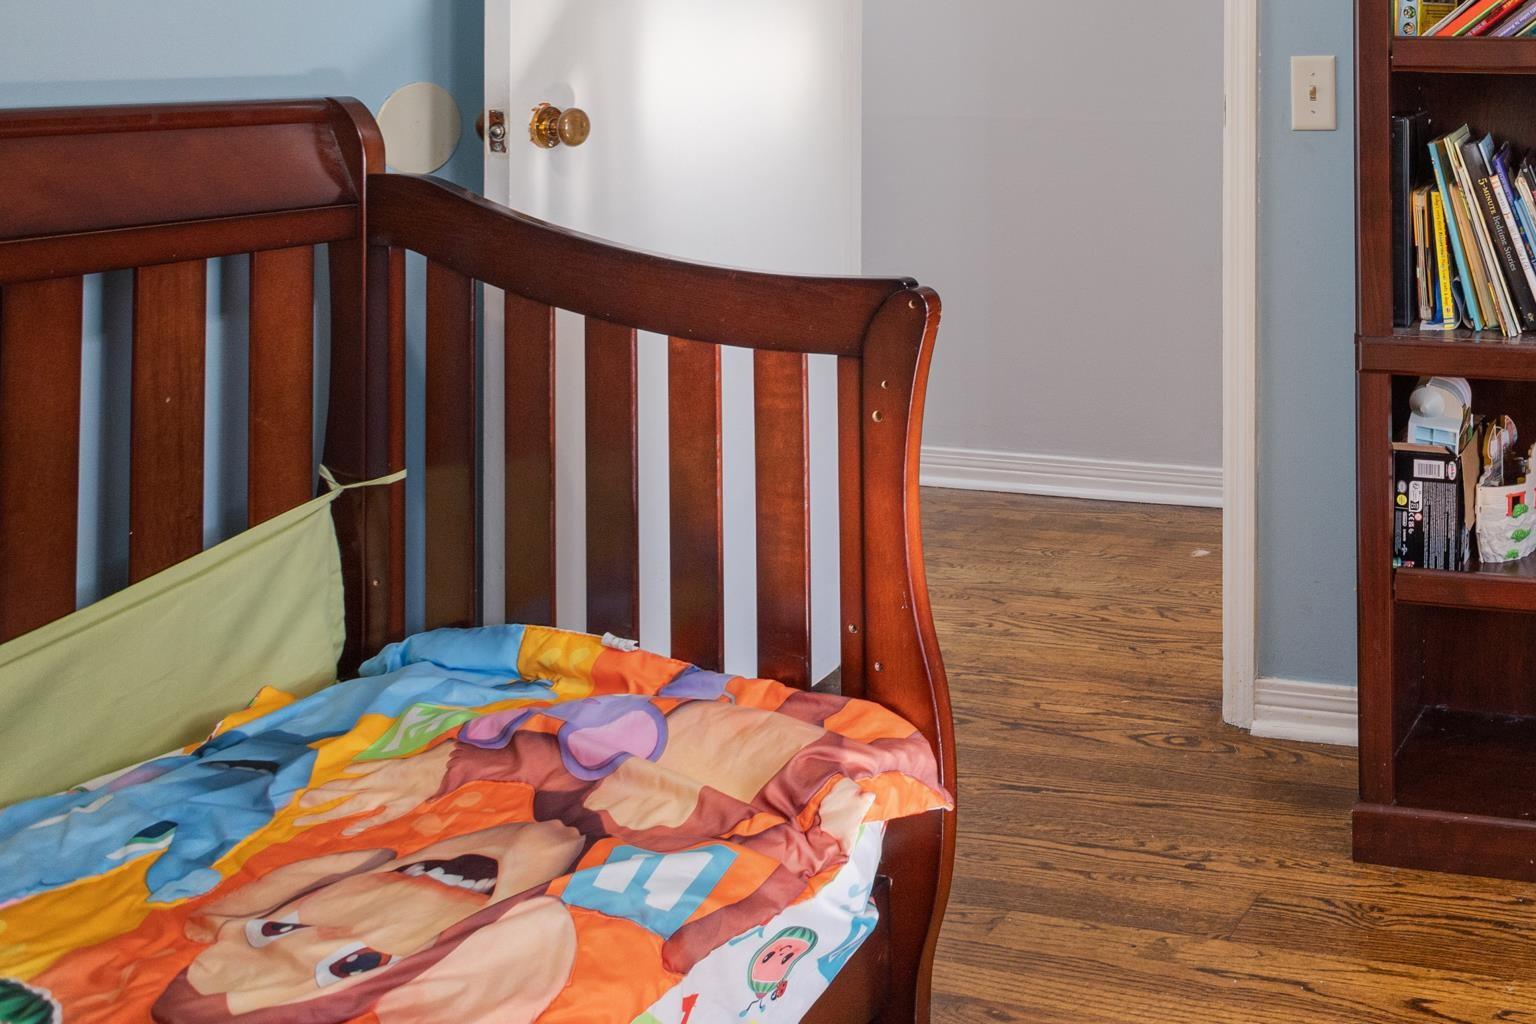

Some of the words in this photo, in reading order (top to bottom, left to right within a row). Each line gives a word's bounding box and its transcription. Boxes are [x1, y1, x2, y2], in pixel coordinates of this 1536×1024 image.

[1477, 177, 1497, 216] 5-MINUTE
[1493, 213, 1509, 247] Bedtime
[1503, 246, 1517, 272] Stories
